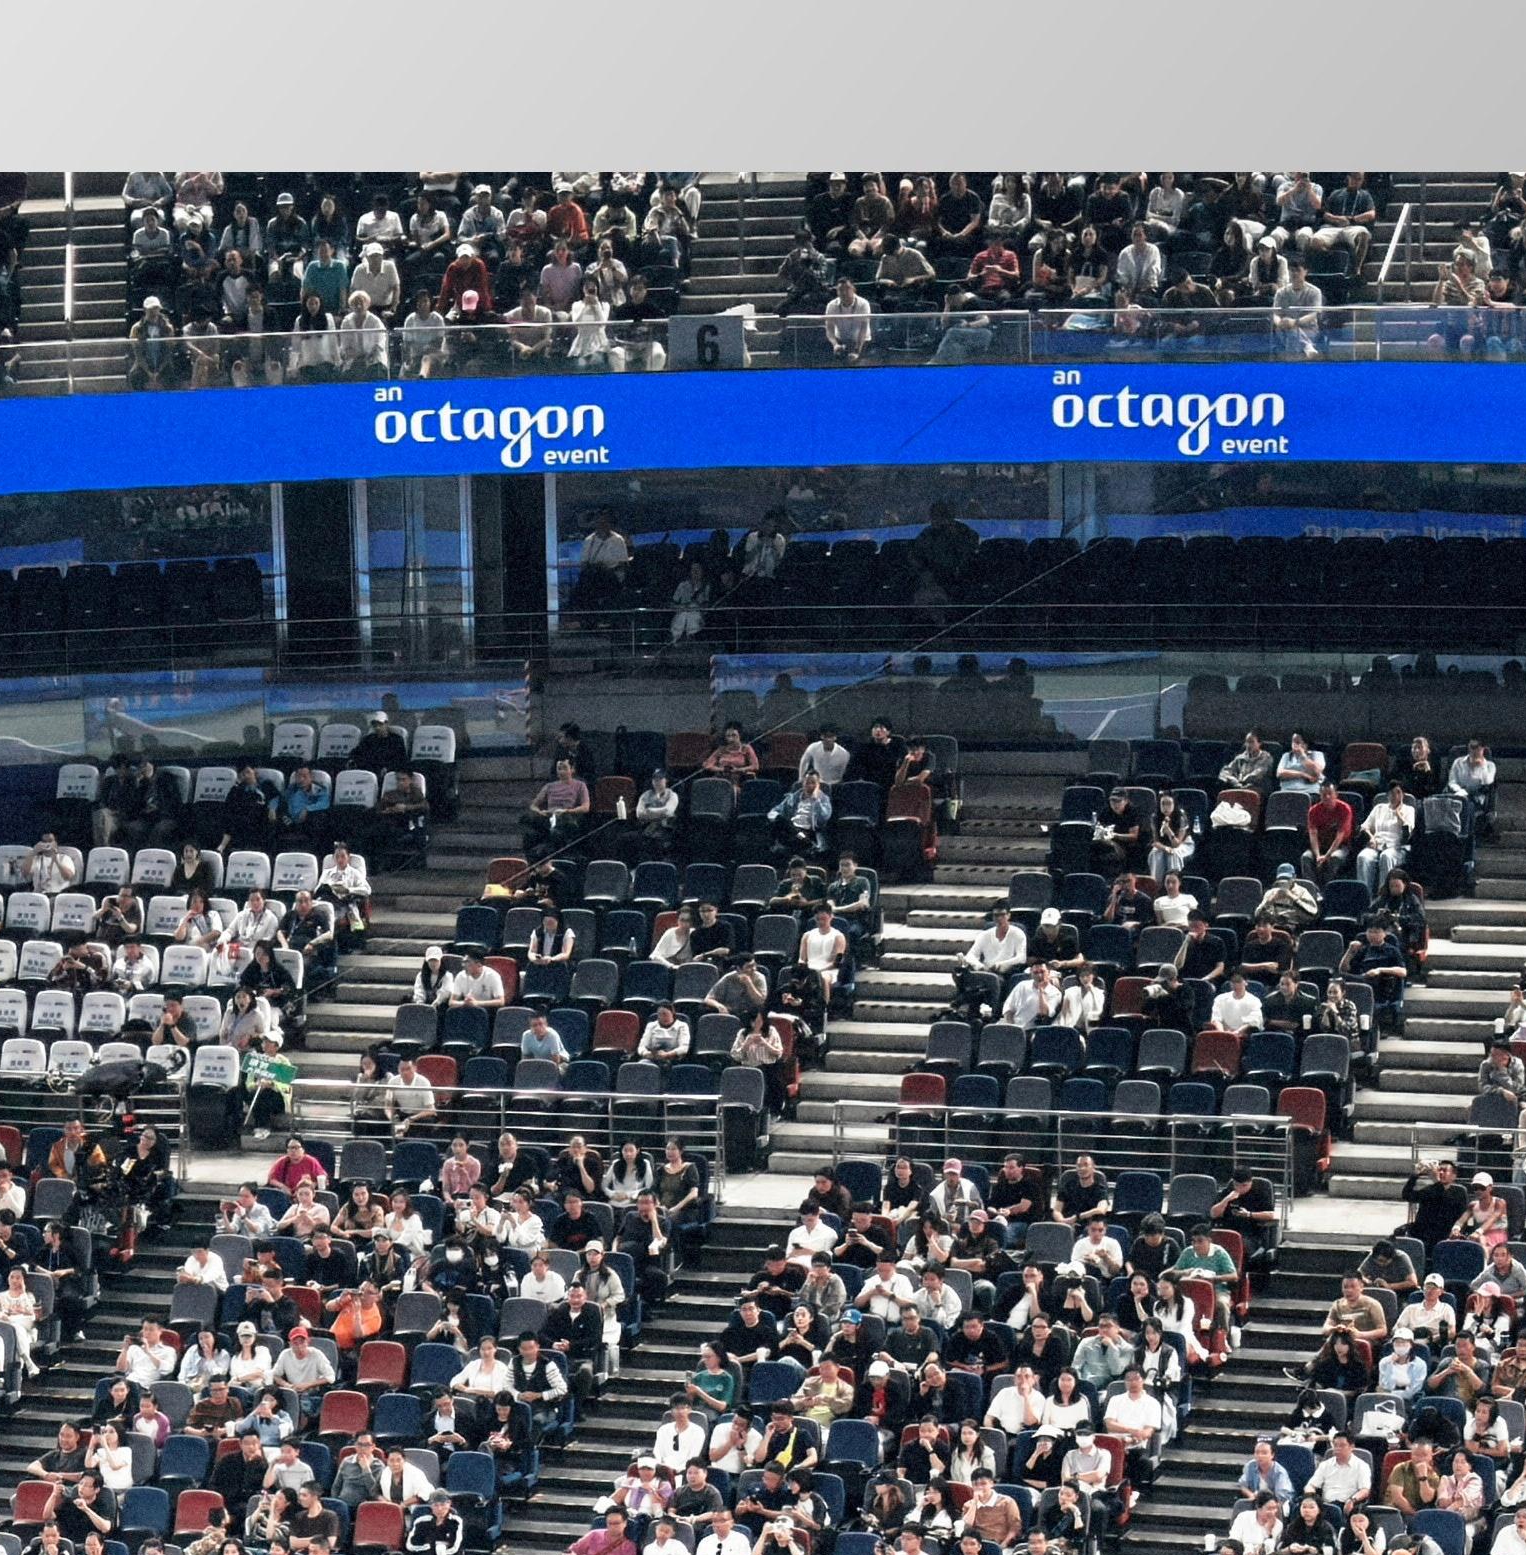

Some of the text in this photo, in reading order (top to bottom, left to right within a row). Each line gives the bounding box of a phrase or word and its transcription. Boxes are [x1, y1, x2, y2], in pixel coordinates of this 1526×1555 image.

[697, 324, 720, 365] 6
[1053, 369, 1081, 385] an
[374, 386, 403, 402] an
[1052, 385, 1285, 456] octagon
[374, 402, 605, 469] octagon
[1221, 435, 1289, 454] event
[543, 446, 610, 465] event
